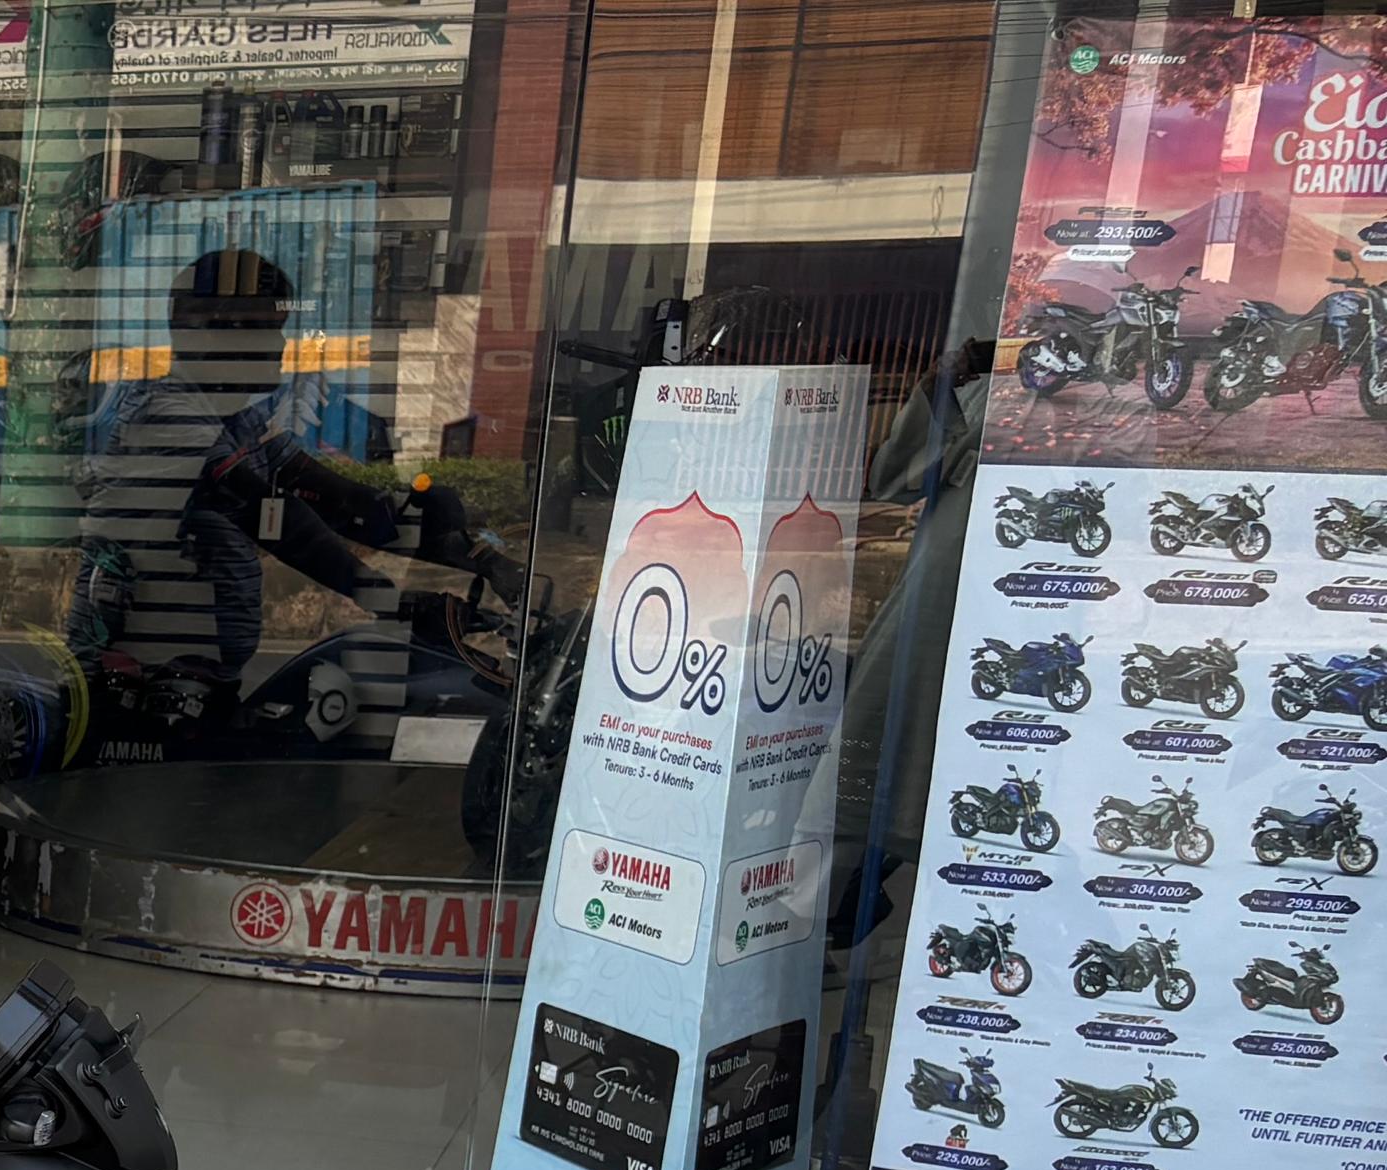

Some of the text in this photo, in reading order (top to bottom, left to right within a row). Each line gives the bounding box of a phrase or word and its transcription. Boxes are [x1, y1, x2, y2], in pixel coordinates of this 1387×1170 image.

[1109, 53, 1187, 65] ACI Motors
[1273, 131, 1387, 167] Cashba
[289, 164, 332, 177] YAMALUBE
[1294, 163, 1387, 194] CARNIV
[1094, 226, 1165, 240] 293,500/-
[673, 387, 703, 405] NRB
[1042, 579, 1109, 594] 675,000/-
[1183, 585, 1251, 599] 678,000/-
[1347, 592, 1387, 606] 625,0
[611, 562, 727, 716] 0%
[754, 568, 832, 713] 0%
[599, 714, 713, 750] EMI on your purchases
[746, 724, 823, 750] EMI on your purchases
[1006, 726, 1061, 741] 606,000/-
[1164, 735, 1223, 749] 601,000/-
[582, 732, 723, 775] with NRB Bank Credit Cards
[784, 744, 807, 761] Credit
[1320, 745, 1380, 759] 521,000/-
[604, 758, 637, 777] Tenure:
[638, 766, 646, 779] 3
[653, 770, 660, 782] 6
[661, 772, 695, 790] Months
[611, 852, 671, 890] YAMAHA
[750, 858, 794, 891] YAMAHA
[981, 870, 1042, 885] 533,000/-
[1129, 883, 1191, 898] 304,000/-
[588, 903, 602, 915] ACI
[1286, 897, 1349, 912] 299,500/-
[300, 888, 537, 960] YAMAH
[608, 913, 663, 940] ACI Motors
[751, 918, 789, 939] ACI Motors
[956, 1012, 1012, 1029] 238,000/-
[554, 1022, 605, 1056] NRB Bank
[1115, 1028, 1168, 1043] 234,000/-
[1271, 1040, 1326, 1056] 525,000/-
[535, 1086, 653, 1145] 4341 8000 0000 0000
[1273, 1112, 1341, 1130] OFFERED
[1342, 1119, 1386, 1135] PRICE
[769, 1134, 791, 1155] VISA
[1251, 1127, 1293, 1142] UNTIL
[1295, 1130, 1359, 1148] FURTHER
[936, 1150, 991, 1168] 225,000/-
